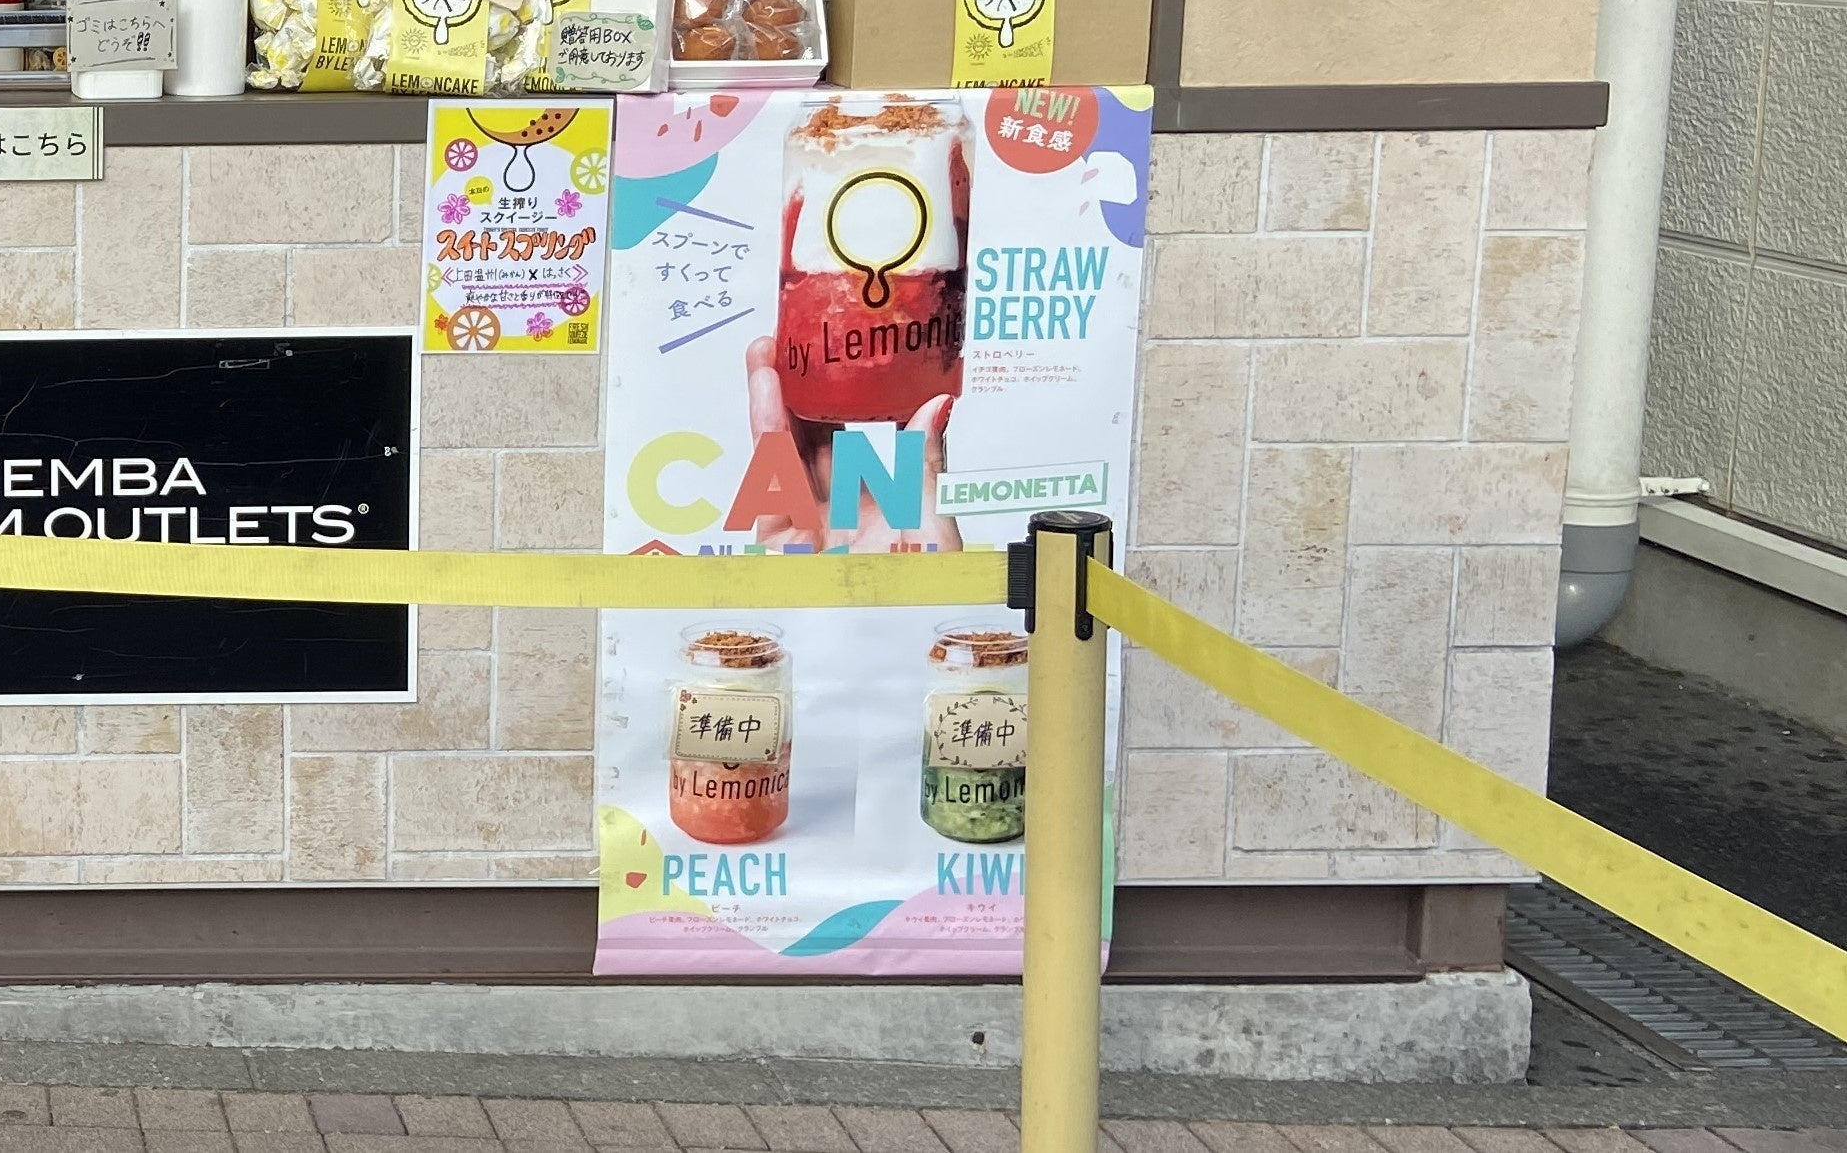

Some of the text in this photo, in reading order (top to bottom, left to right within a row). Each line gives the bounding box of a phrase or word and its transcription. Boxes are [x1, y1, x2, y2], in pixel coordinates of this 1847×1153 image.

[76, 16, 166, 35] ゴミはこちらへ
[560, 24, 632, 46] 贈答用BOX
[315, 55, 333, 70] BY
[558, 48, 647, 72] ご用意しております
[391, 72, 480, 94] LEMONCAKE
[1013, 87, 1081, 126] NEW!
[998, 116, 1074, 153] 新食感
[480, 210, 557, 224] スクイージー
[498, 196, 538, 209] 生搾り
[651, 231, 752, 261] スプーンで
[655, 262, 732, 282] すくって
[974, 246, 1110, 293] STRAW
[667, 291, 733, 322] 食べる
[973, 295, 1096, 341] BERRY
[788, 336, 812, 377] by
[972, 349, 1035, 359] ストロベリー
[626, 430, 926, 536] CAN
[939, 473, 1098, 505] LEMONETTA
[689, 712, 761, 743] 準備中
[951, 719, 1015, 748] 準備中
[673, 768, 789, 800] by Lemonica
[923, 781, 938, 806] by
[662, 852, 787, 896] PEACH
[936, 852, 1025, 896] KIWI
[711, 904, 741, 913] ピーチ
[966, 903, 997, 913] キウイ
